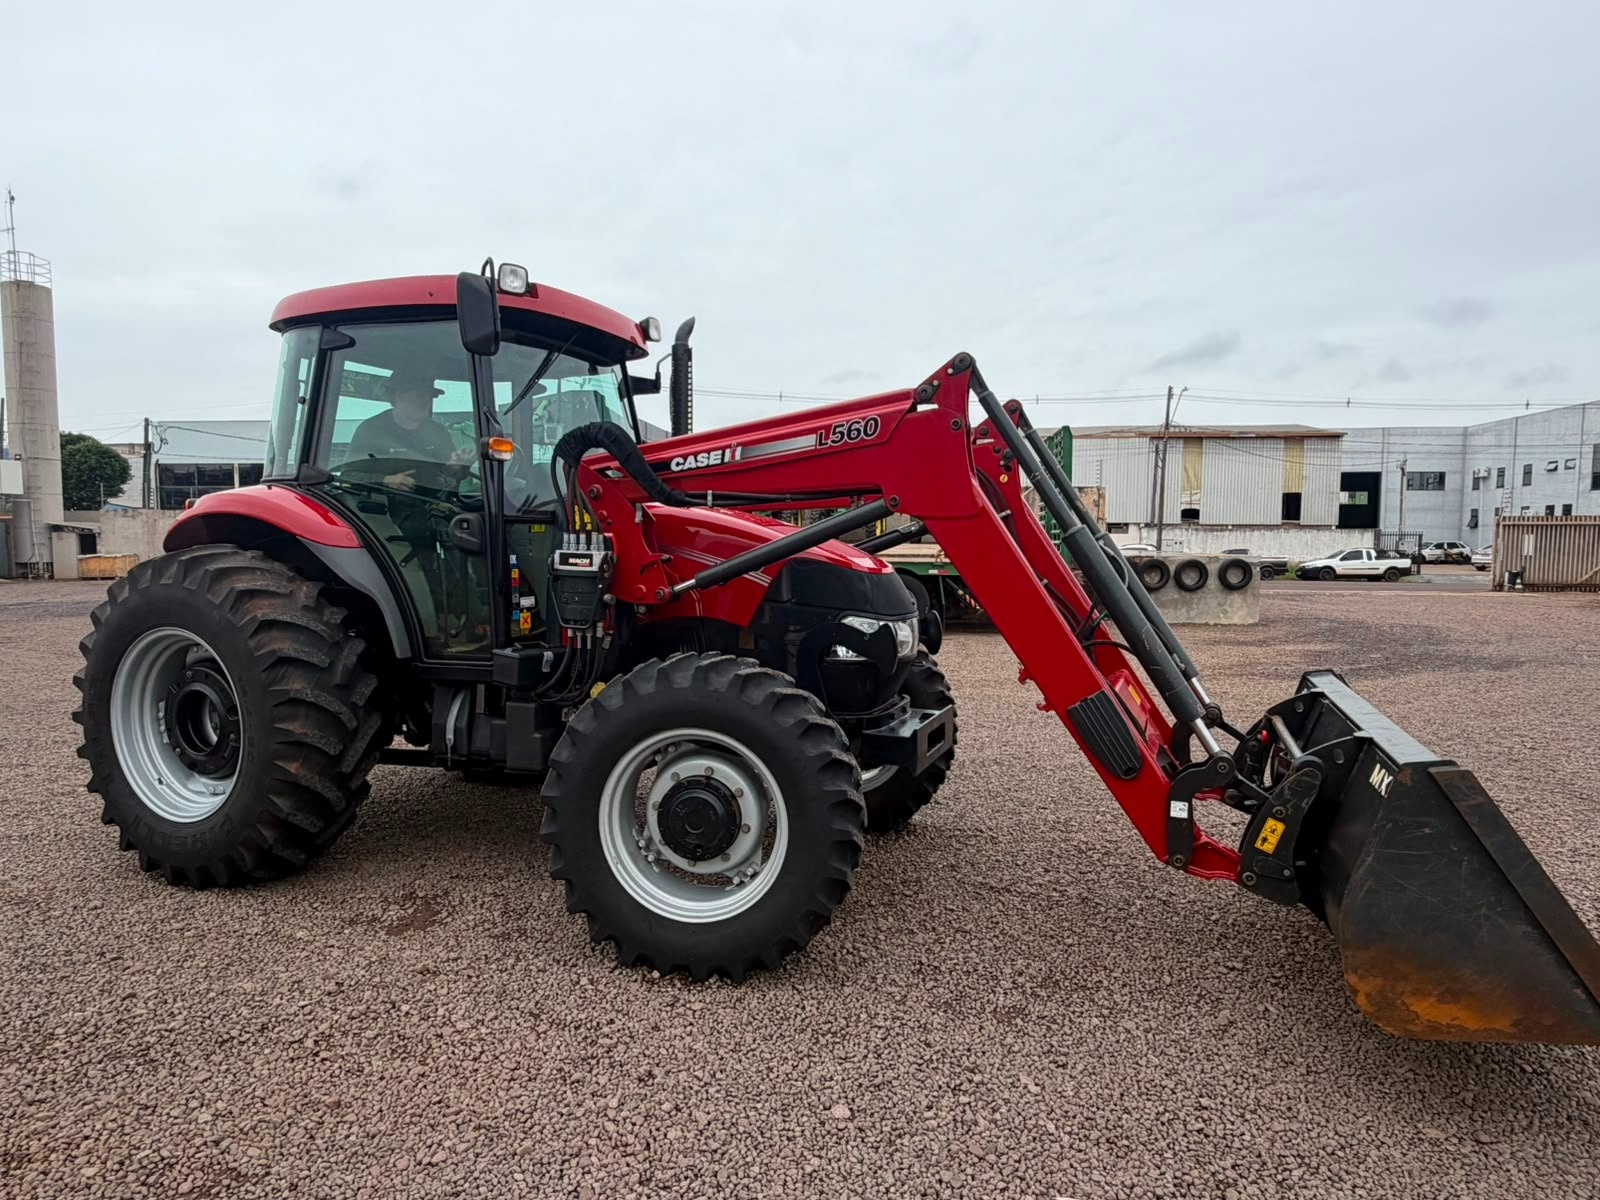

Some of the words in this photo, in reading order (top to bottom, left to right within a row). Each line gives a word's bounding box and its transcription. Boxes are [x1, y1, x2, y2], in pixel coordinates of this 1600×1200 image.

[816, 415, 880, 448] L560
[670, 451, 722, 472] CASE
[1369, 763, 1394, 797] MX
